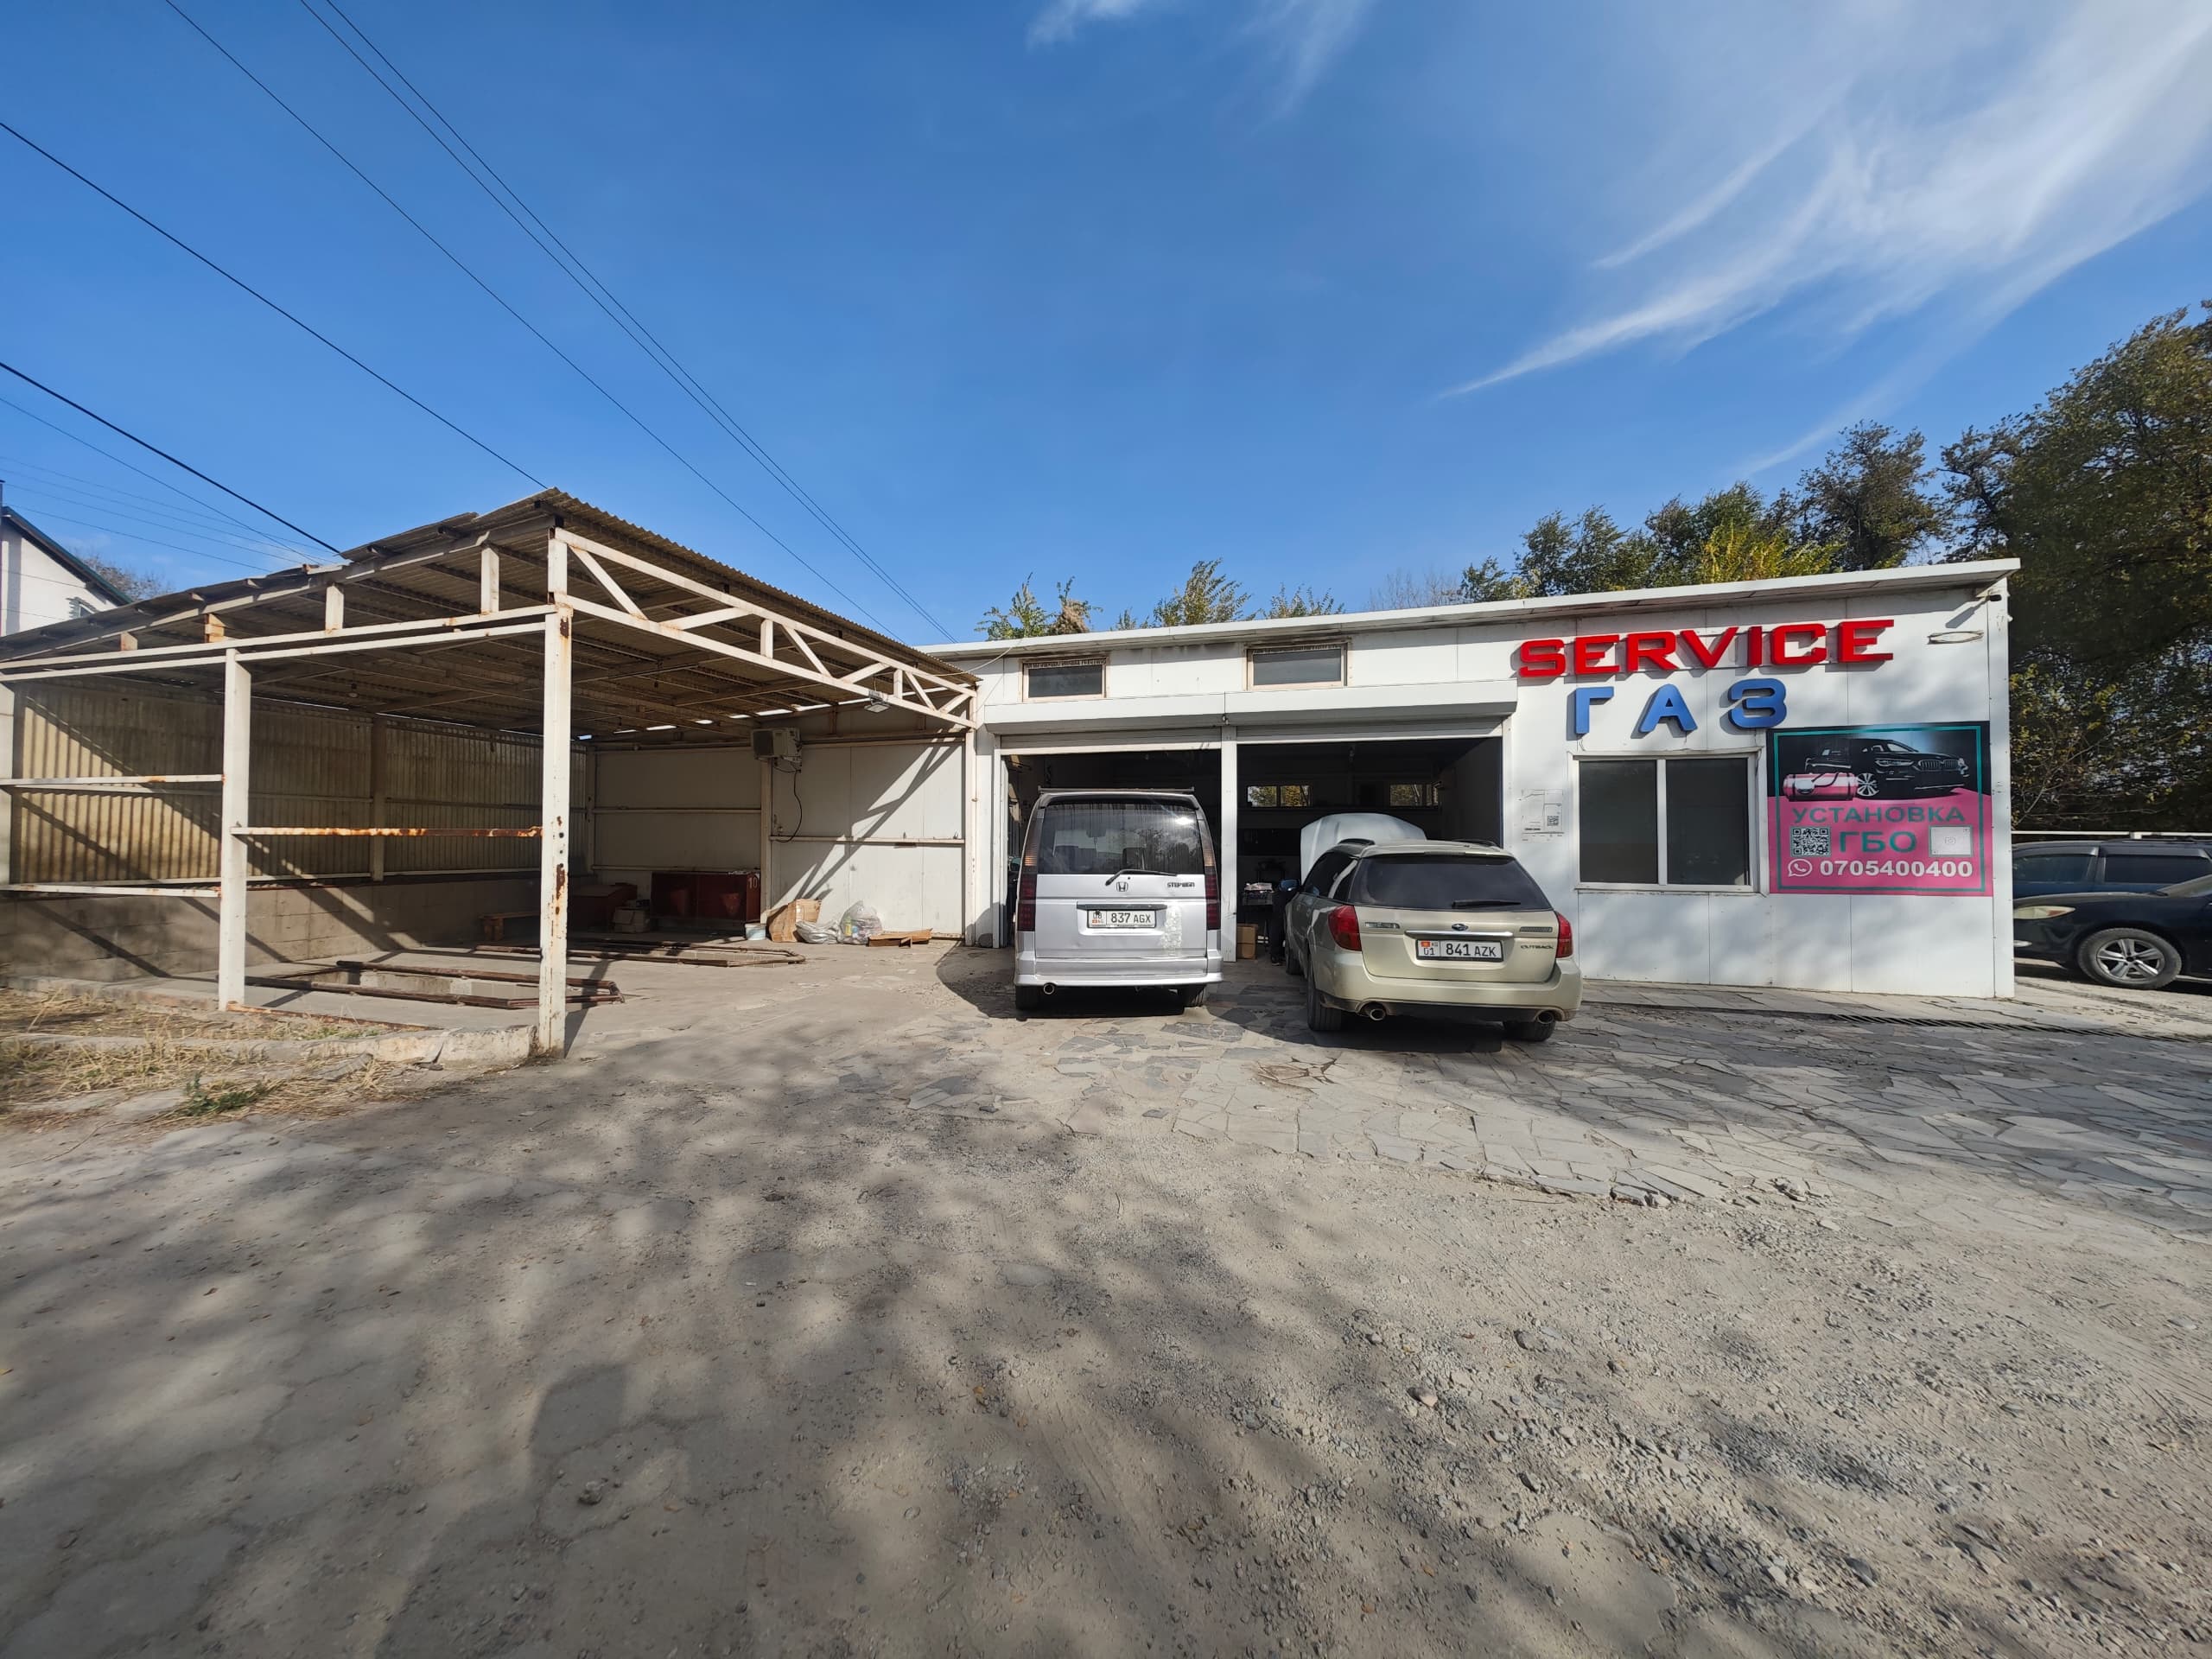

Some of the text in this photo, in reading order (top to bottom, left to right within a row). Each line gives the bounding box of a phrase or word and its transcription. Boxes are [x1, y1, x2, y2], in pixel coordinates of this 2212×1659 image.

[1518, 619, 1895, 678] SERVICE
[1575, 678, 1787, 734] ГАЗ
[1792, 806, 1966, 823] УСТАНОВКА
[1839, 830, 1917, 853] ГБО
[1820, 860, 1974, 878] 0705400400
[1110, 912, 1131, 924] 837
[1133, 914, 1152, 924] AGX
[1446, 943, 1471, 957] 841
[1474, 945, 1497, 957] AZK
